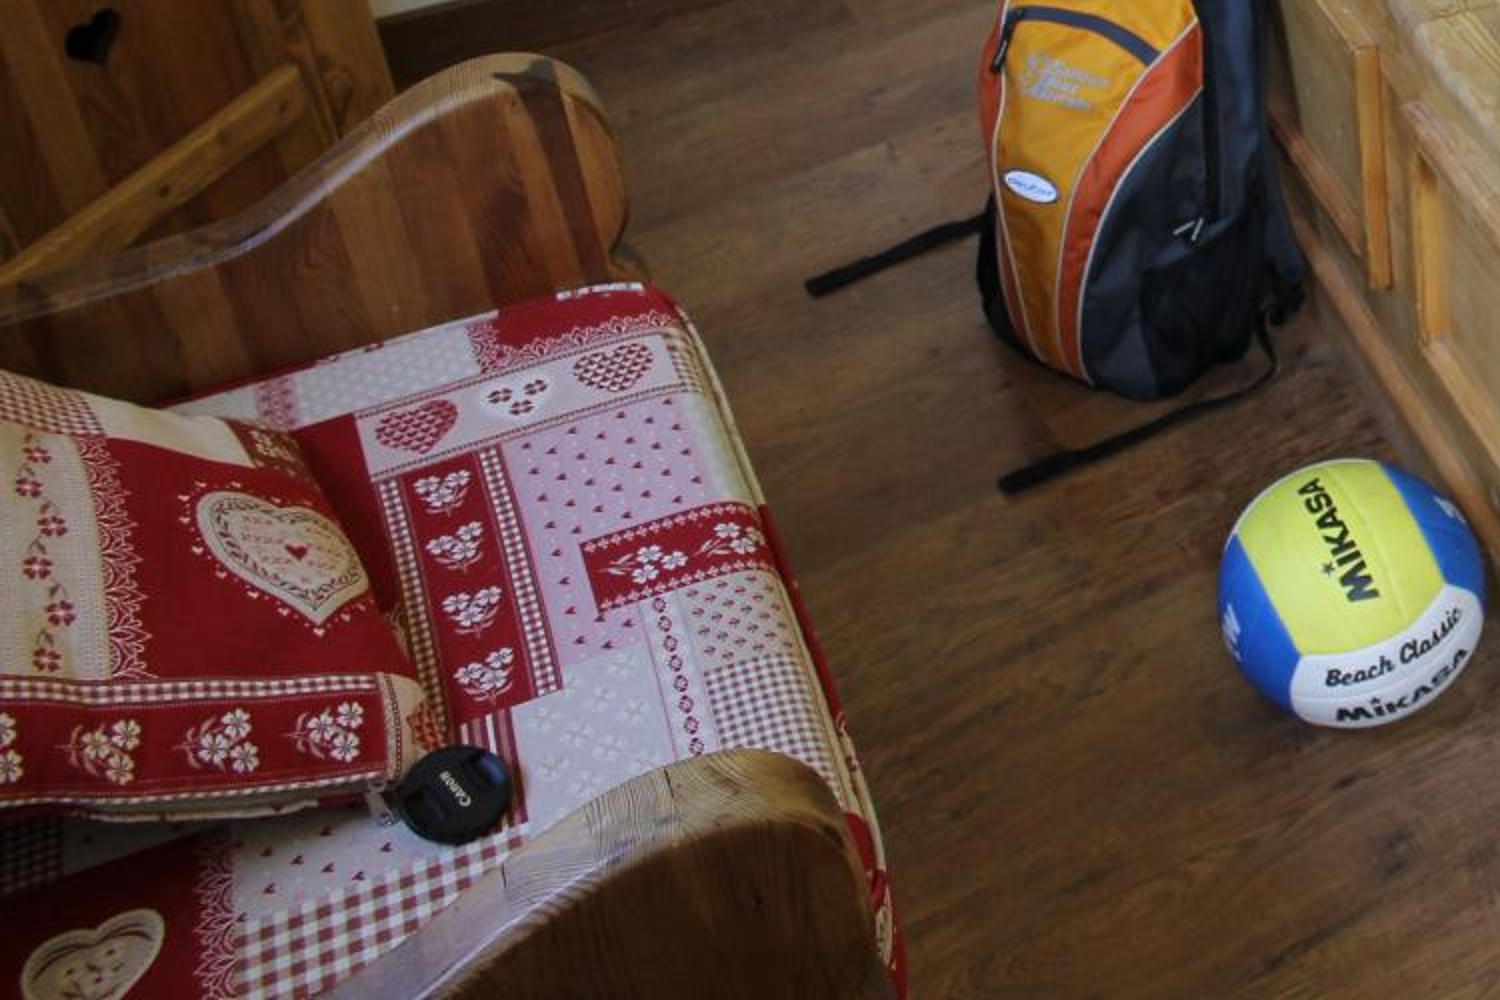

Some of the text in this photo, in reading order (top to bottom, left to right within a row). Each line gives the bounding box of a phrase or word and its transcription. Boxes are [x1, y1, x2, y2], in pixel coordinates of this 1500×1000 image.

[1297, 477, 1380, 603] MIKASA
[1325, 608, 1461, 686] Beach Classic
